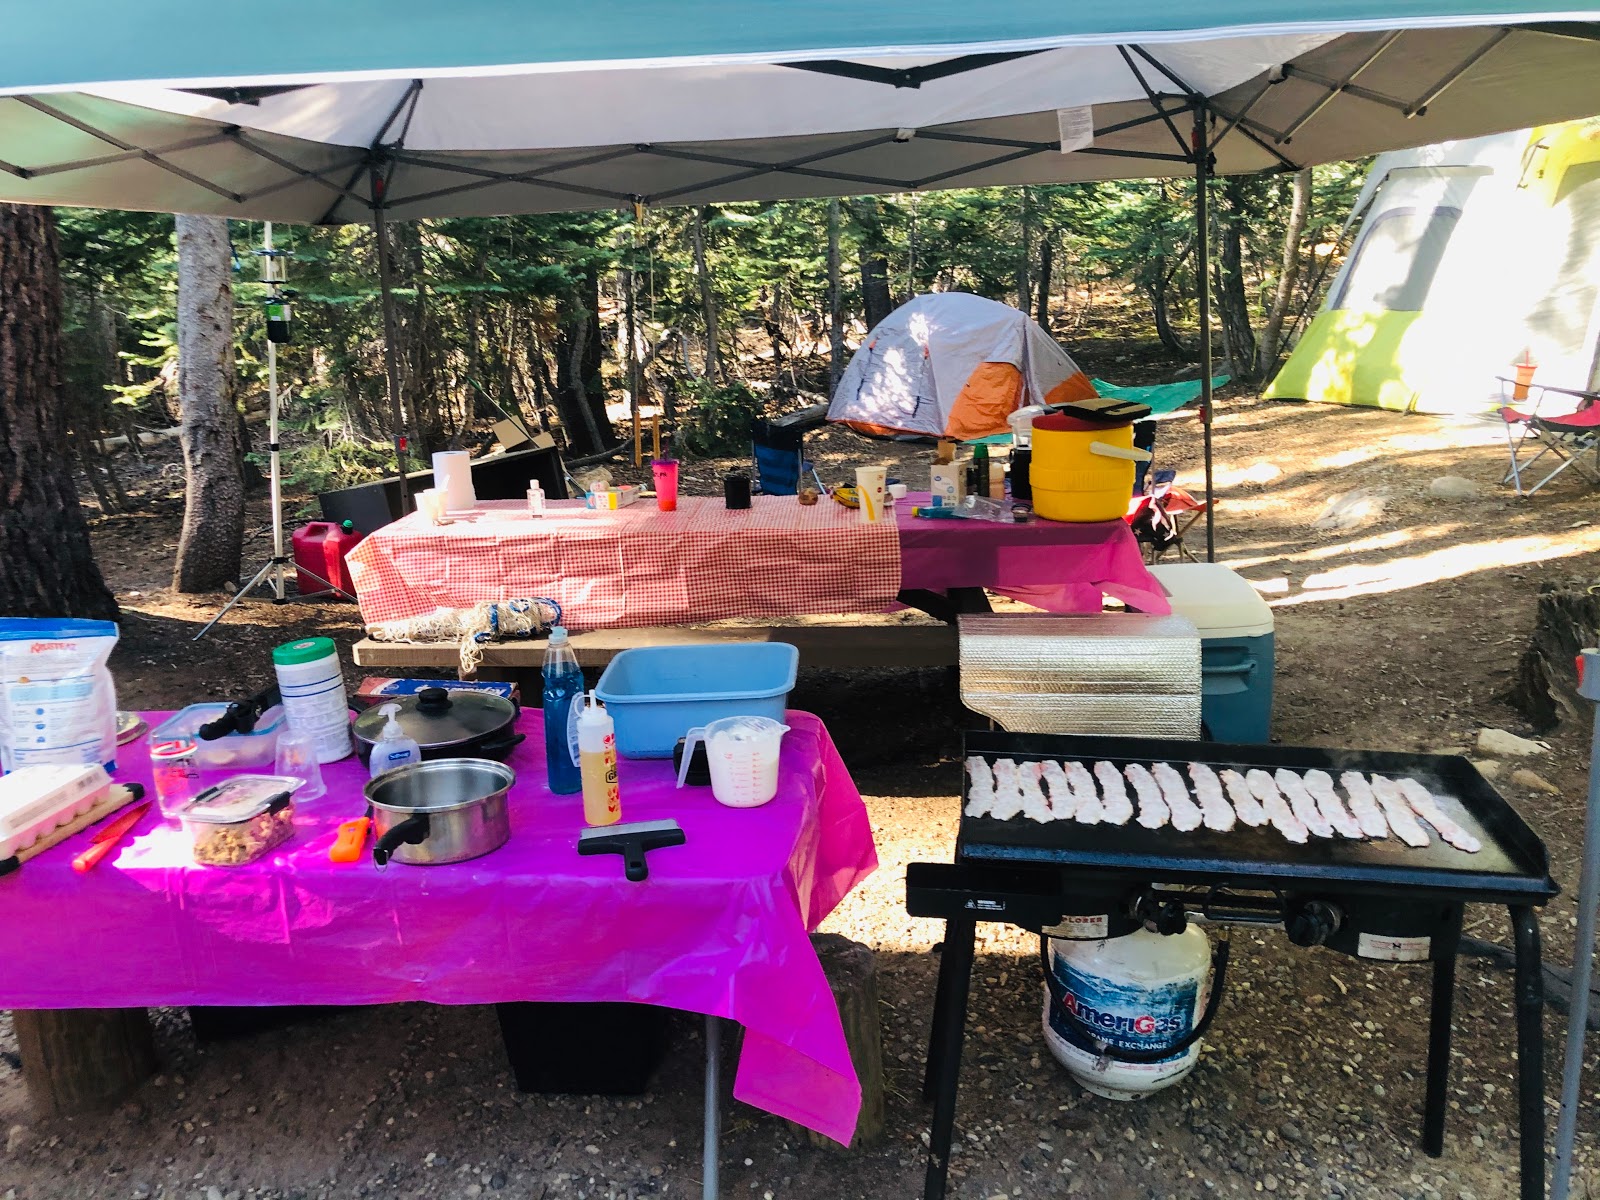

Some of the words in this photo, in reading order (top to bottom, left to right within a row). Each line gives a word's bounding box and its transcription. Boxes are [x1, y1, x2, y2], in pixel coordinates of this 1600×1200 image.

[1061, 916, 1103, 924] PLORER
[1062, 991, 1182, 1034] AmeriGas
[1087, 1030, 1114, 1045] PANE
[1119, 1040, 1168, 1051] EXCHANGE
